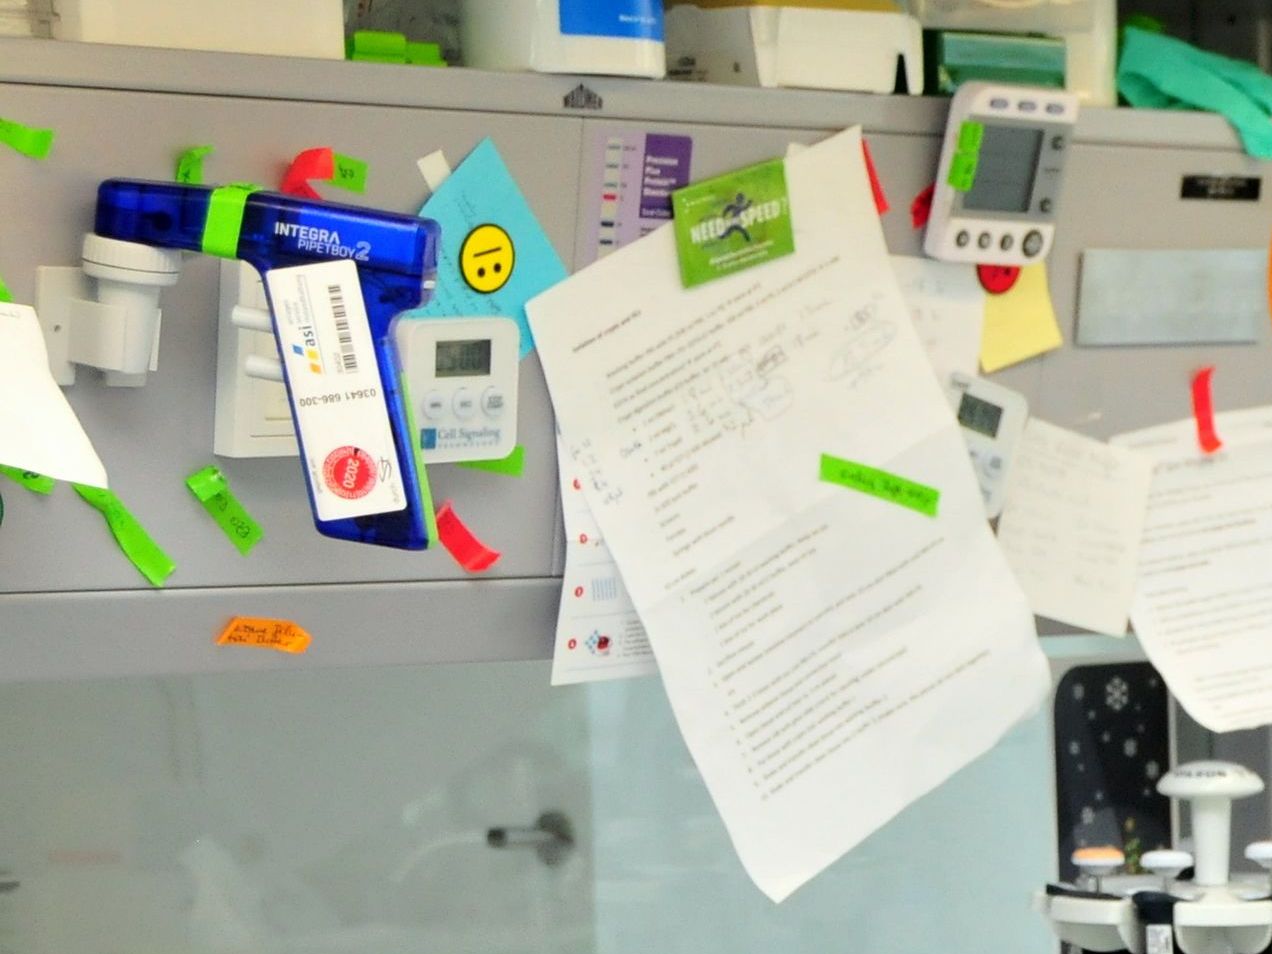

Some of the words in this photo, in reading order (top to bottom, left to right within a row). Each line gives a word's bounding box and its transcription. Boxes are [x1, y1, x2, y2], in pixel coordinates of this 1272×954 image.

[741, 200, 780, 228] SPEED
[274, 221, 340, 245] INTEGRA
[298, 325, 316, 347] asi
[438, 427, 457, 440] Cell
[459, 426, 501, 441] Signaling
[342, 458, 360, 489] 2020
